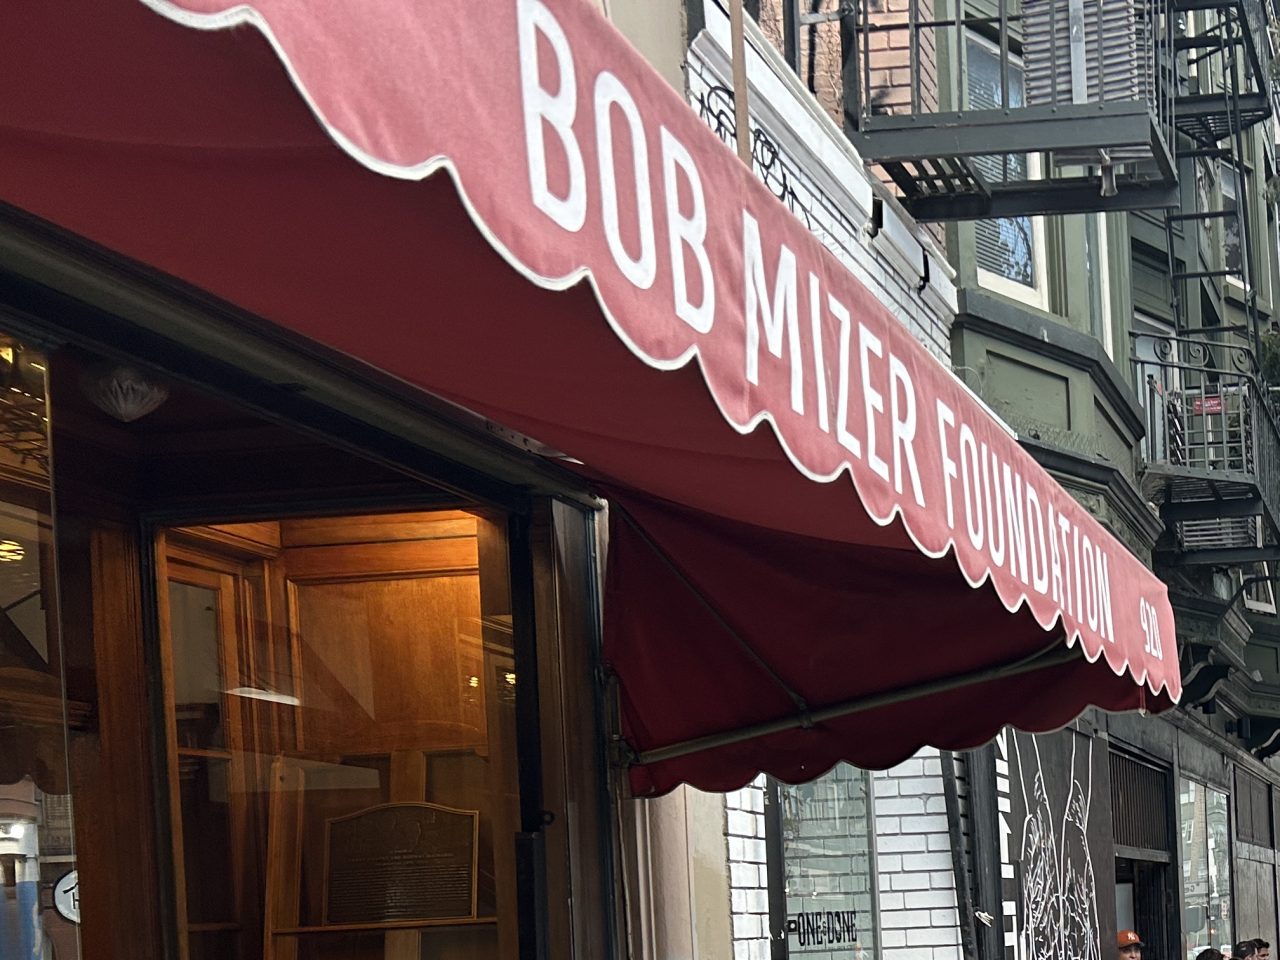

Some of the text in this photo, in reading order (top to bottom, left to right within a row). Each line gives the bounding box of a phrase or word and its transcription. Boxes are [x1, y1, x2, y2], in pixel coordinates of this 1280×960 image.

[516, 0, 715, 334] BOB
[743, 209, 925, 509] MIZER
[937, 399, 1116, 643] FOUNDATION
[1139, 595, 1164, 661] 920
[797, 911, 823, 946] ONE
[826, 910, 857, 944] DONE
